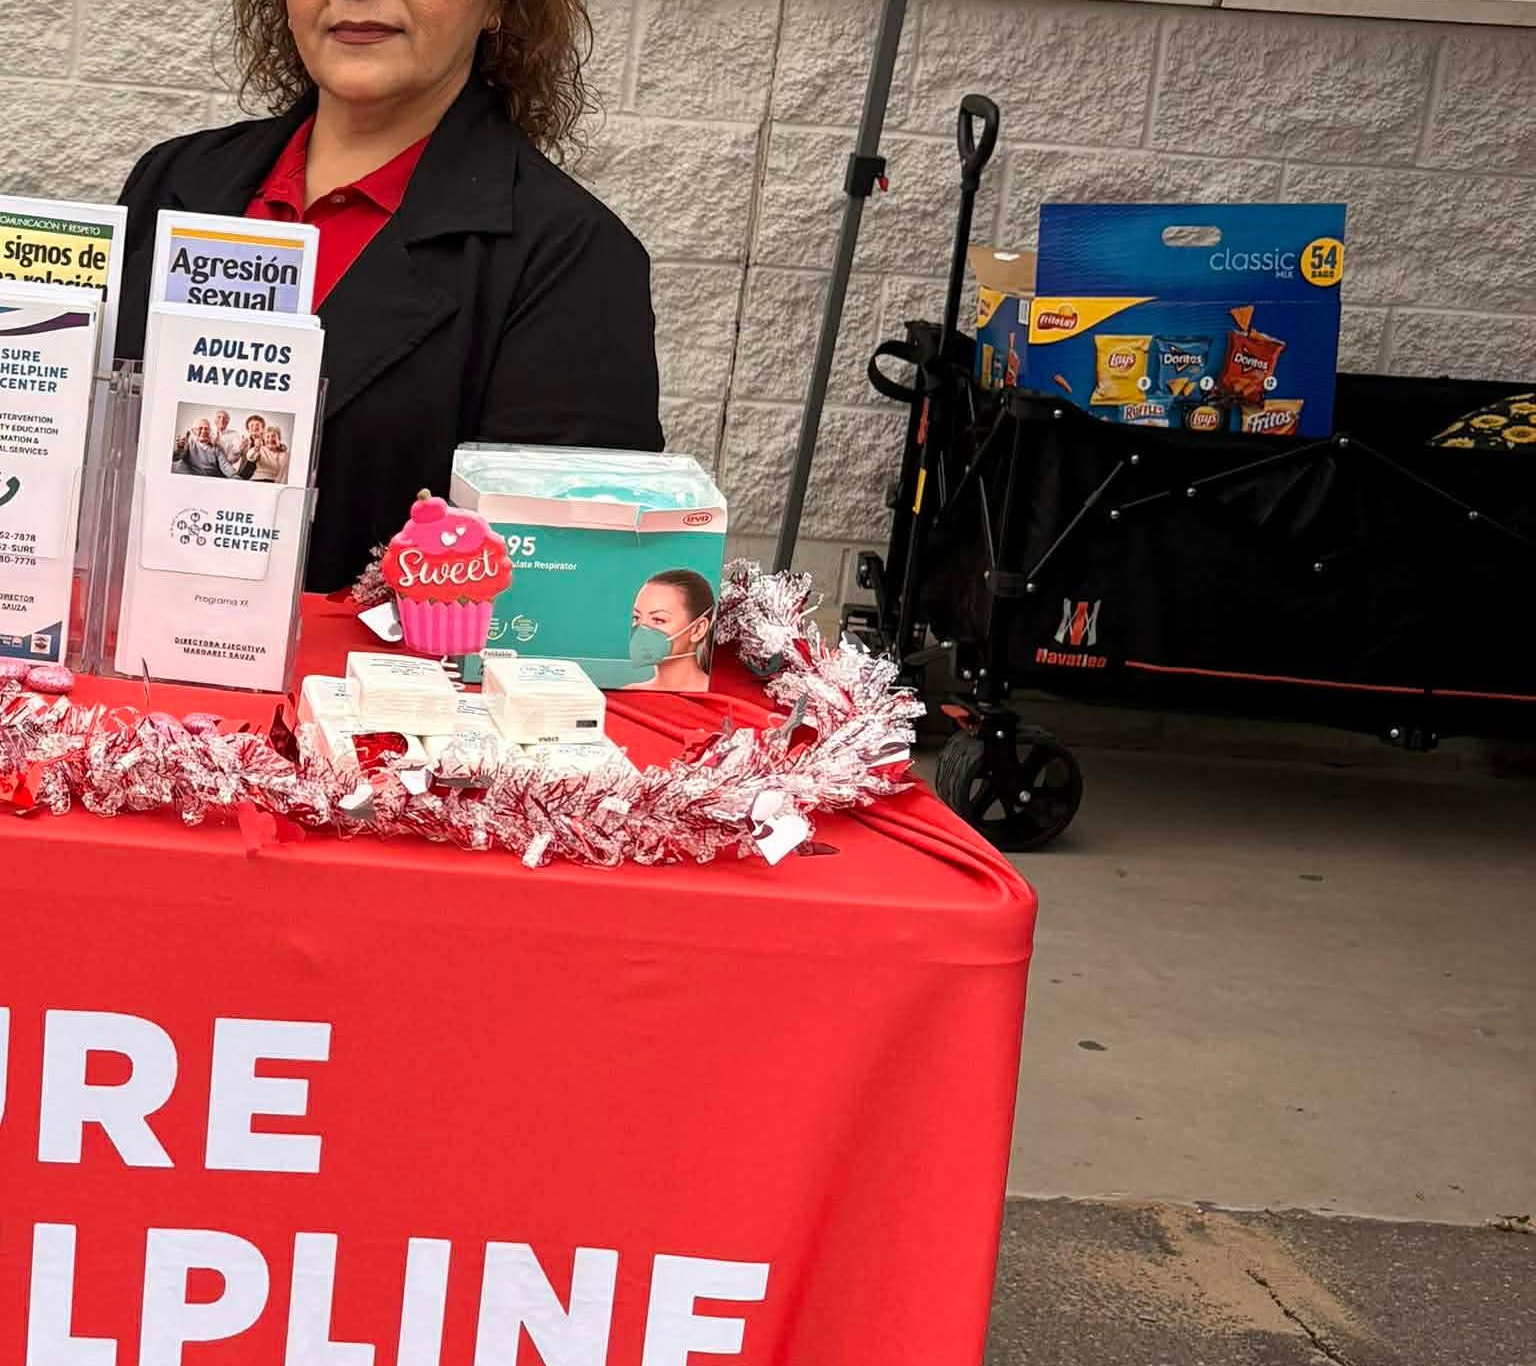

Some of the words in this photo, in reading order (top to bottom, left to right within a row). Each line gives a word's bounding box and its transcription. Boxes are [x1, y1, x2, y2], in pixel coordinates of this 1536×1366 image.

[62, 222, 68, 231] Y
[69, 224, 101, 236] RESPETO
[4, 235, 73, 268] signos
[78, 244, 106, 270] de
[1209, 247, 1295, 271] classic
[1310, 245, 1337, 270] 54
[170, 247, 299, 286] Agresión
[187, 285, 276, 312] sexual
[1, 348, 41, 363] SURE
[192, 337, 292, 364] ADULTOS
[1164, 354, 1202, 365] Doritos
[1234, 352, 1269, 370] Doritos
[0, 363, 69, 379] HELPLINE
[187, 364, 292, 392] MAYORES
[0, 378, 58, 393] CENTER
[11, 424, 59, 435] EDUCATION
[1248, 409, 1292, 434] Fritos
[9, 446, 49, 456] SERVICES
[216, 510, 254, 524] SURE
[214, 524, 280, 541] HELPLINE
[213, 537, 270, 552] CENTER
[506, 535, 537, 556] 95
[397, 548, 500, 589] Sweet
[534, 561, 578, 572] Respirator
[194, 594, 238, 607] Programa
[174, 636, 220, 649] DIRECTORA
[221, 641, 267, 654] EJECUTIVA
[183, 647, 228, 658] MARGARET
